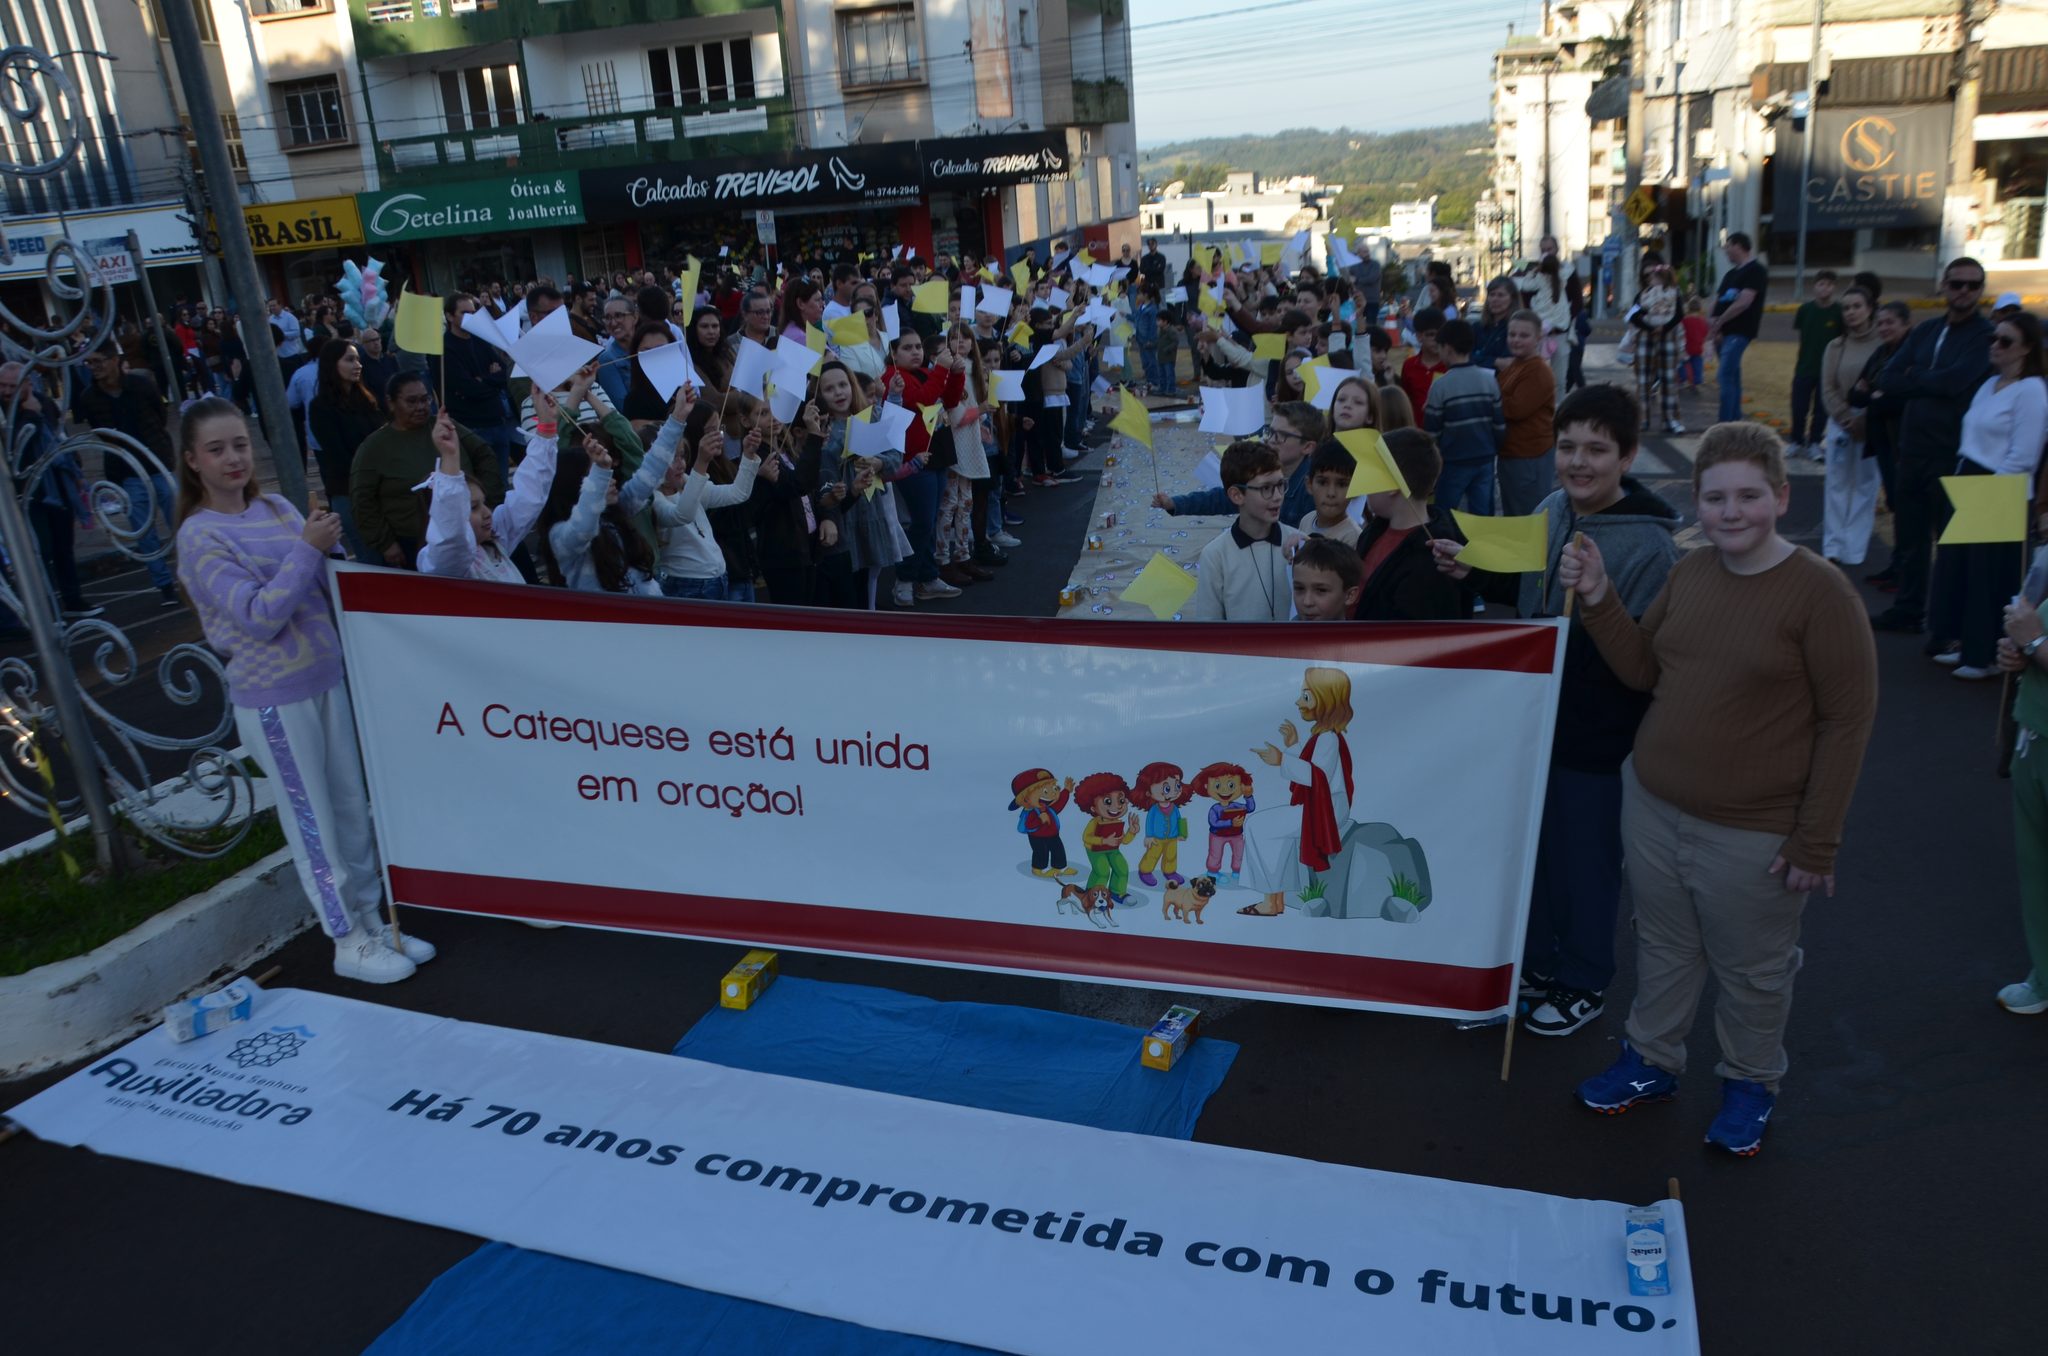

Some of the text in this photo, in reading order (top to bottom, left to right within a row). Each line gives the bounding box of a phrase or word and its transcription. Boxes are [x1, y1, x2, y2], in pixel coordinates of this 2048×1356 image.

[930, 152, 1040, 178] Calçados TREVISOL
[510, 178, 567, 198] Ótica &
[626, 163, 820, 207] Calçados TREVISOL
[1807, 171, 1937, 203] CASTIE
[508, 200, 577, 222] Joalheria
[436, 702, 931, 771] A Catequese está unida
[577, 773, 804, 818] em oração!
[88, 1057, 314, 1126] Auxiliadora
[200, 1062, 246, 1082] Nossa
[248, 1074, 309, 1094] Senhora
[388, 1089, 1677, 1333] Há 70 anos comprometida com o futuro.
